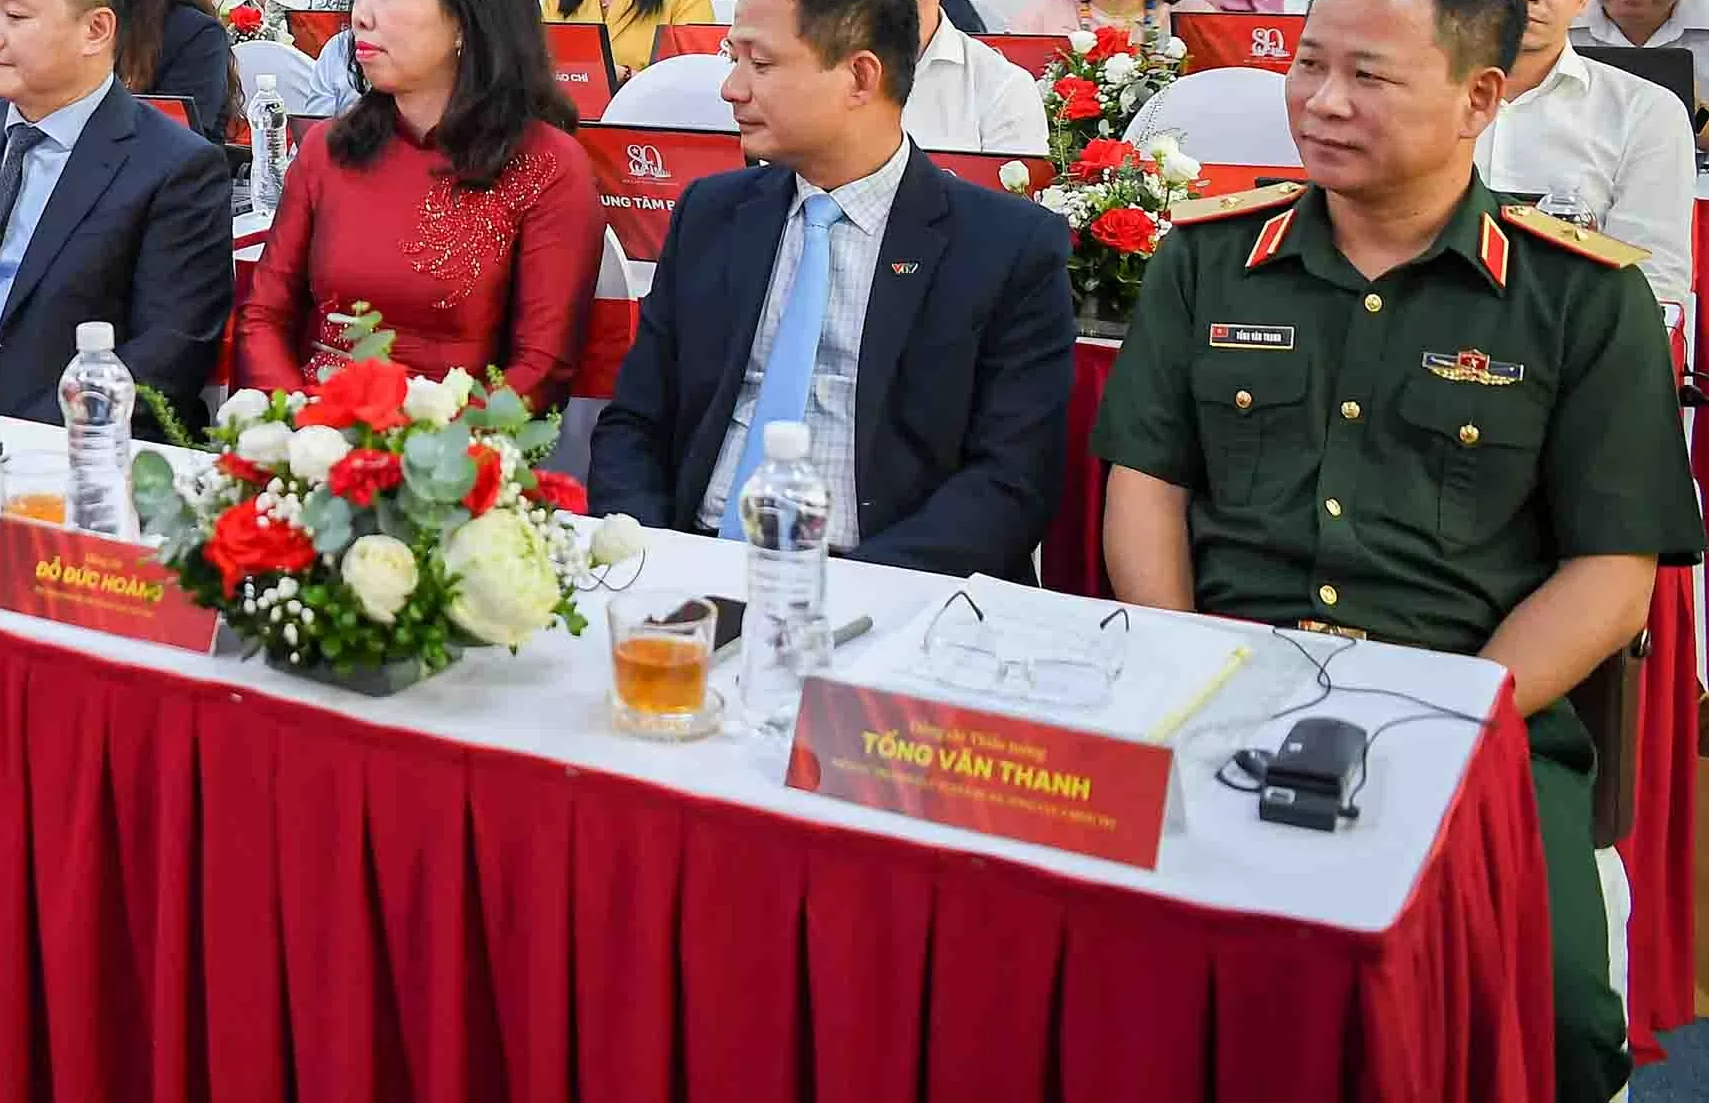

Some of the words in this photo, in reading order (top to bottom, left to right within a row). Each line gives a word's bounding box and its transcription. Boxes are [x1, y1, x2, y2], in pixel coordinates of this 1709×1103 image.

[599, 194, 632, 208] UNG
[632, 195, 665, 210] TÂM
[860, 729, 933, 767] TỐNG
[937, 747, 993, 782] VĂN
[999, 760, 1092, 802] THANH
